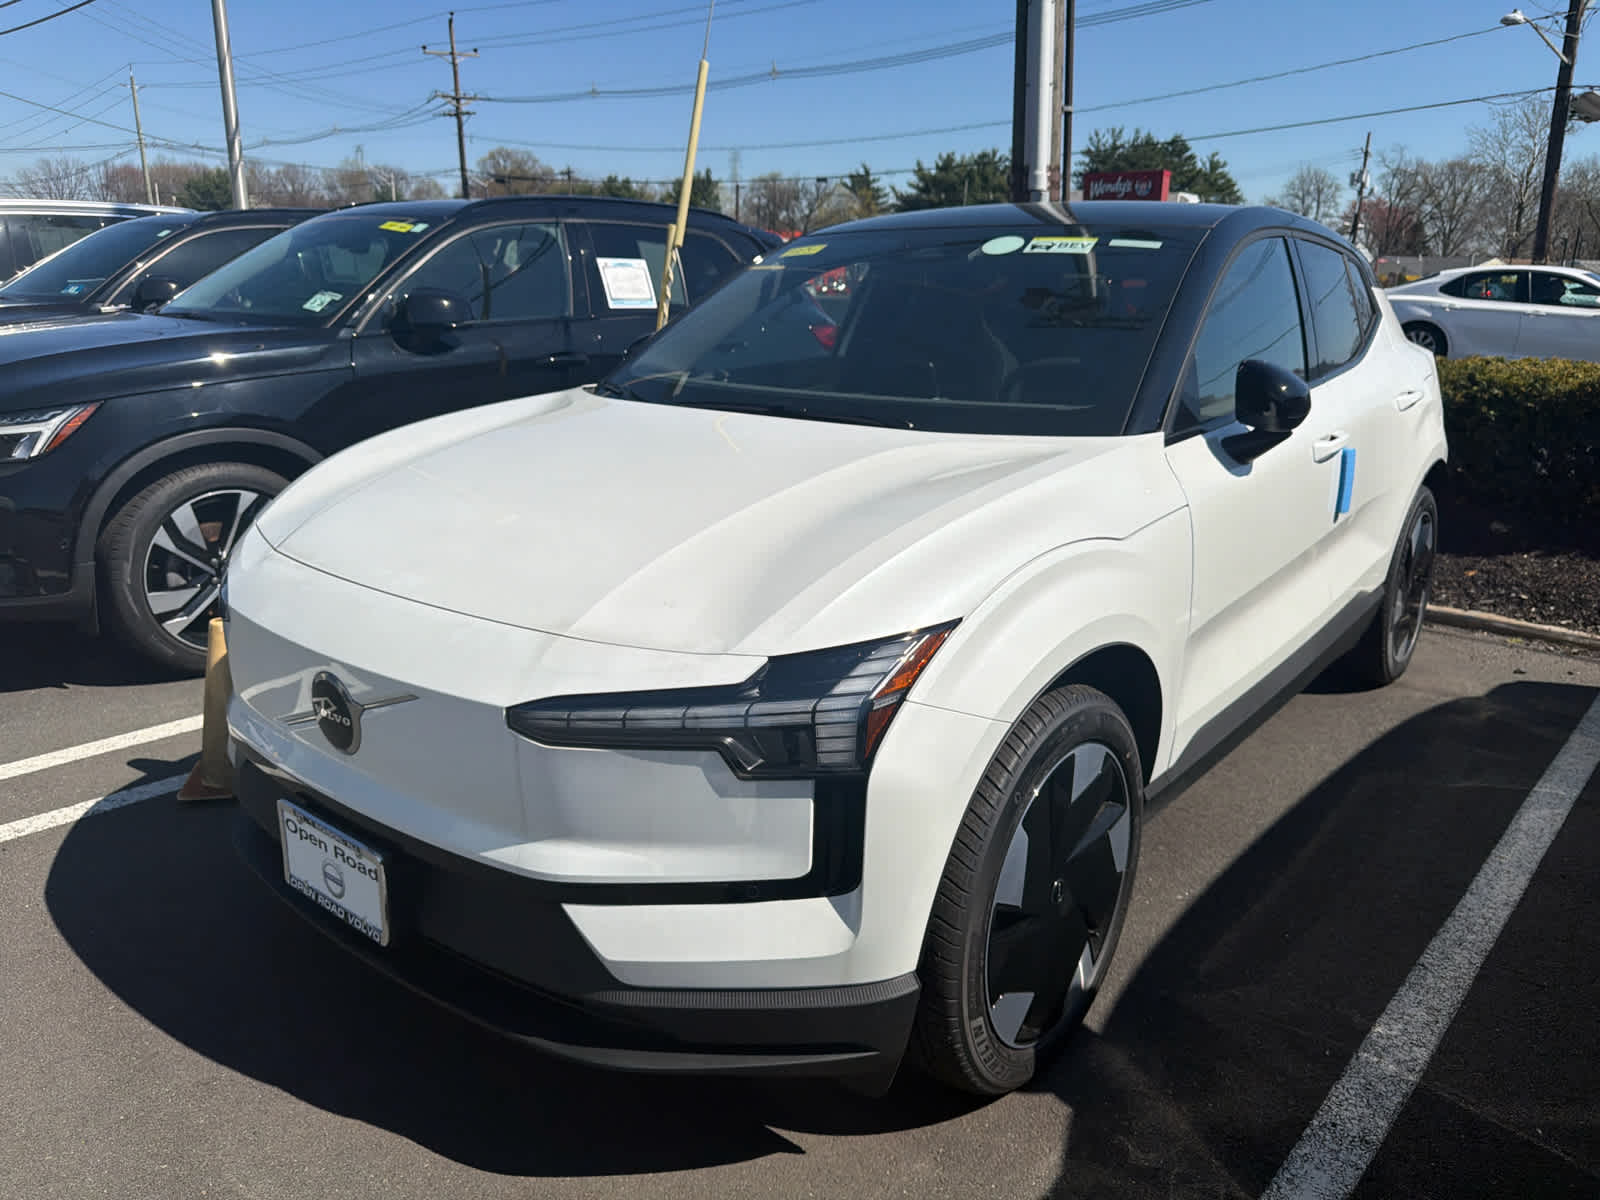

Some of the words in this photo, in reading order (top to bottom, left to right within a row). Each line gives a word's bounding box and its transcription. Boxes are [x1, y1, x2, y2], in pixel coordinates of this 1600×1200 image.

[1090, 175, 1133, 199] Wendy's
[314, 702, 351, 727] VOLVO
[286, 818, 328, 853] Open
[333, 844, 379, 883] Road
[289, 876, 318, 901] OPEN
[318, 895, 346, 920] ROAD
[347, 911, 382, 943] VOLVO
